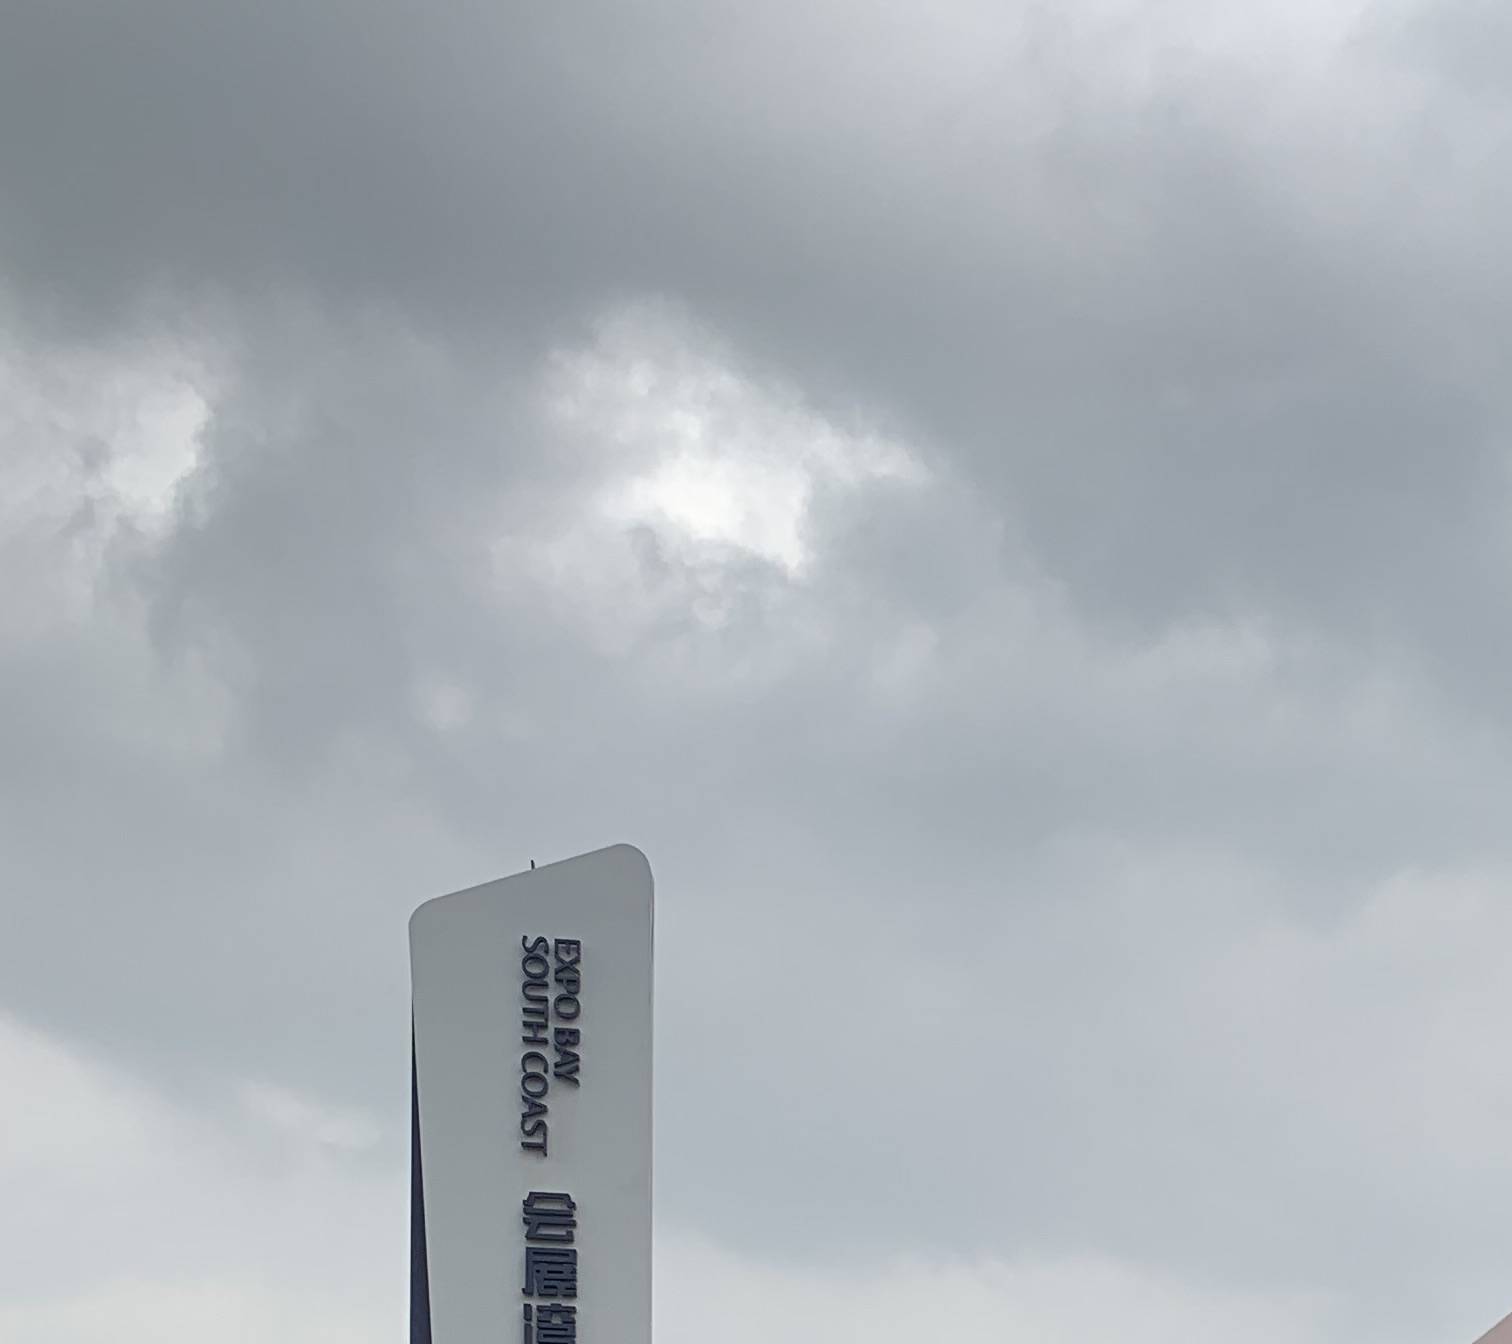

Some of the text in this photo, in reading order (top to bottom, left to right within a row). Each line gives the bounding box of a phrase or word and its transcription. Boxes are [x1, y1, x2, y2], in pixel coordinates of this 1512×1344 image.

[520, 935, 550, 1157] SOUTH COAST
[553, 938, 581, 1088] EXPO BAY
